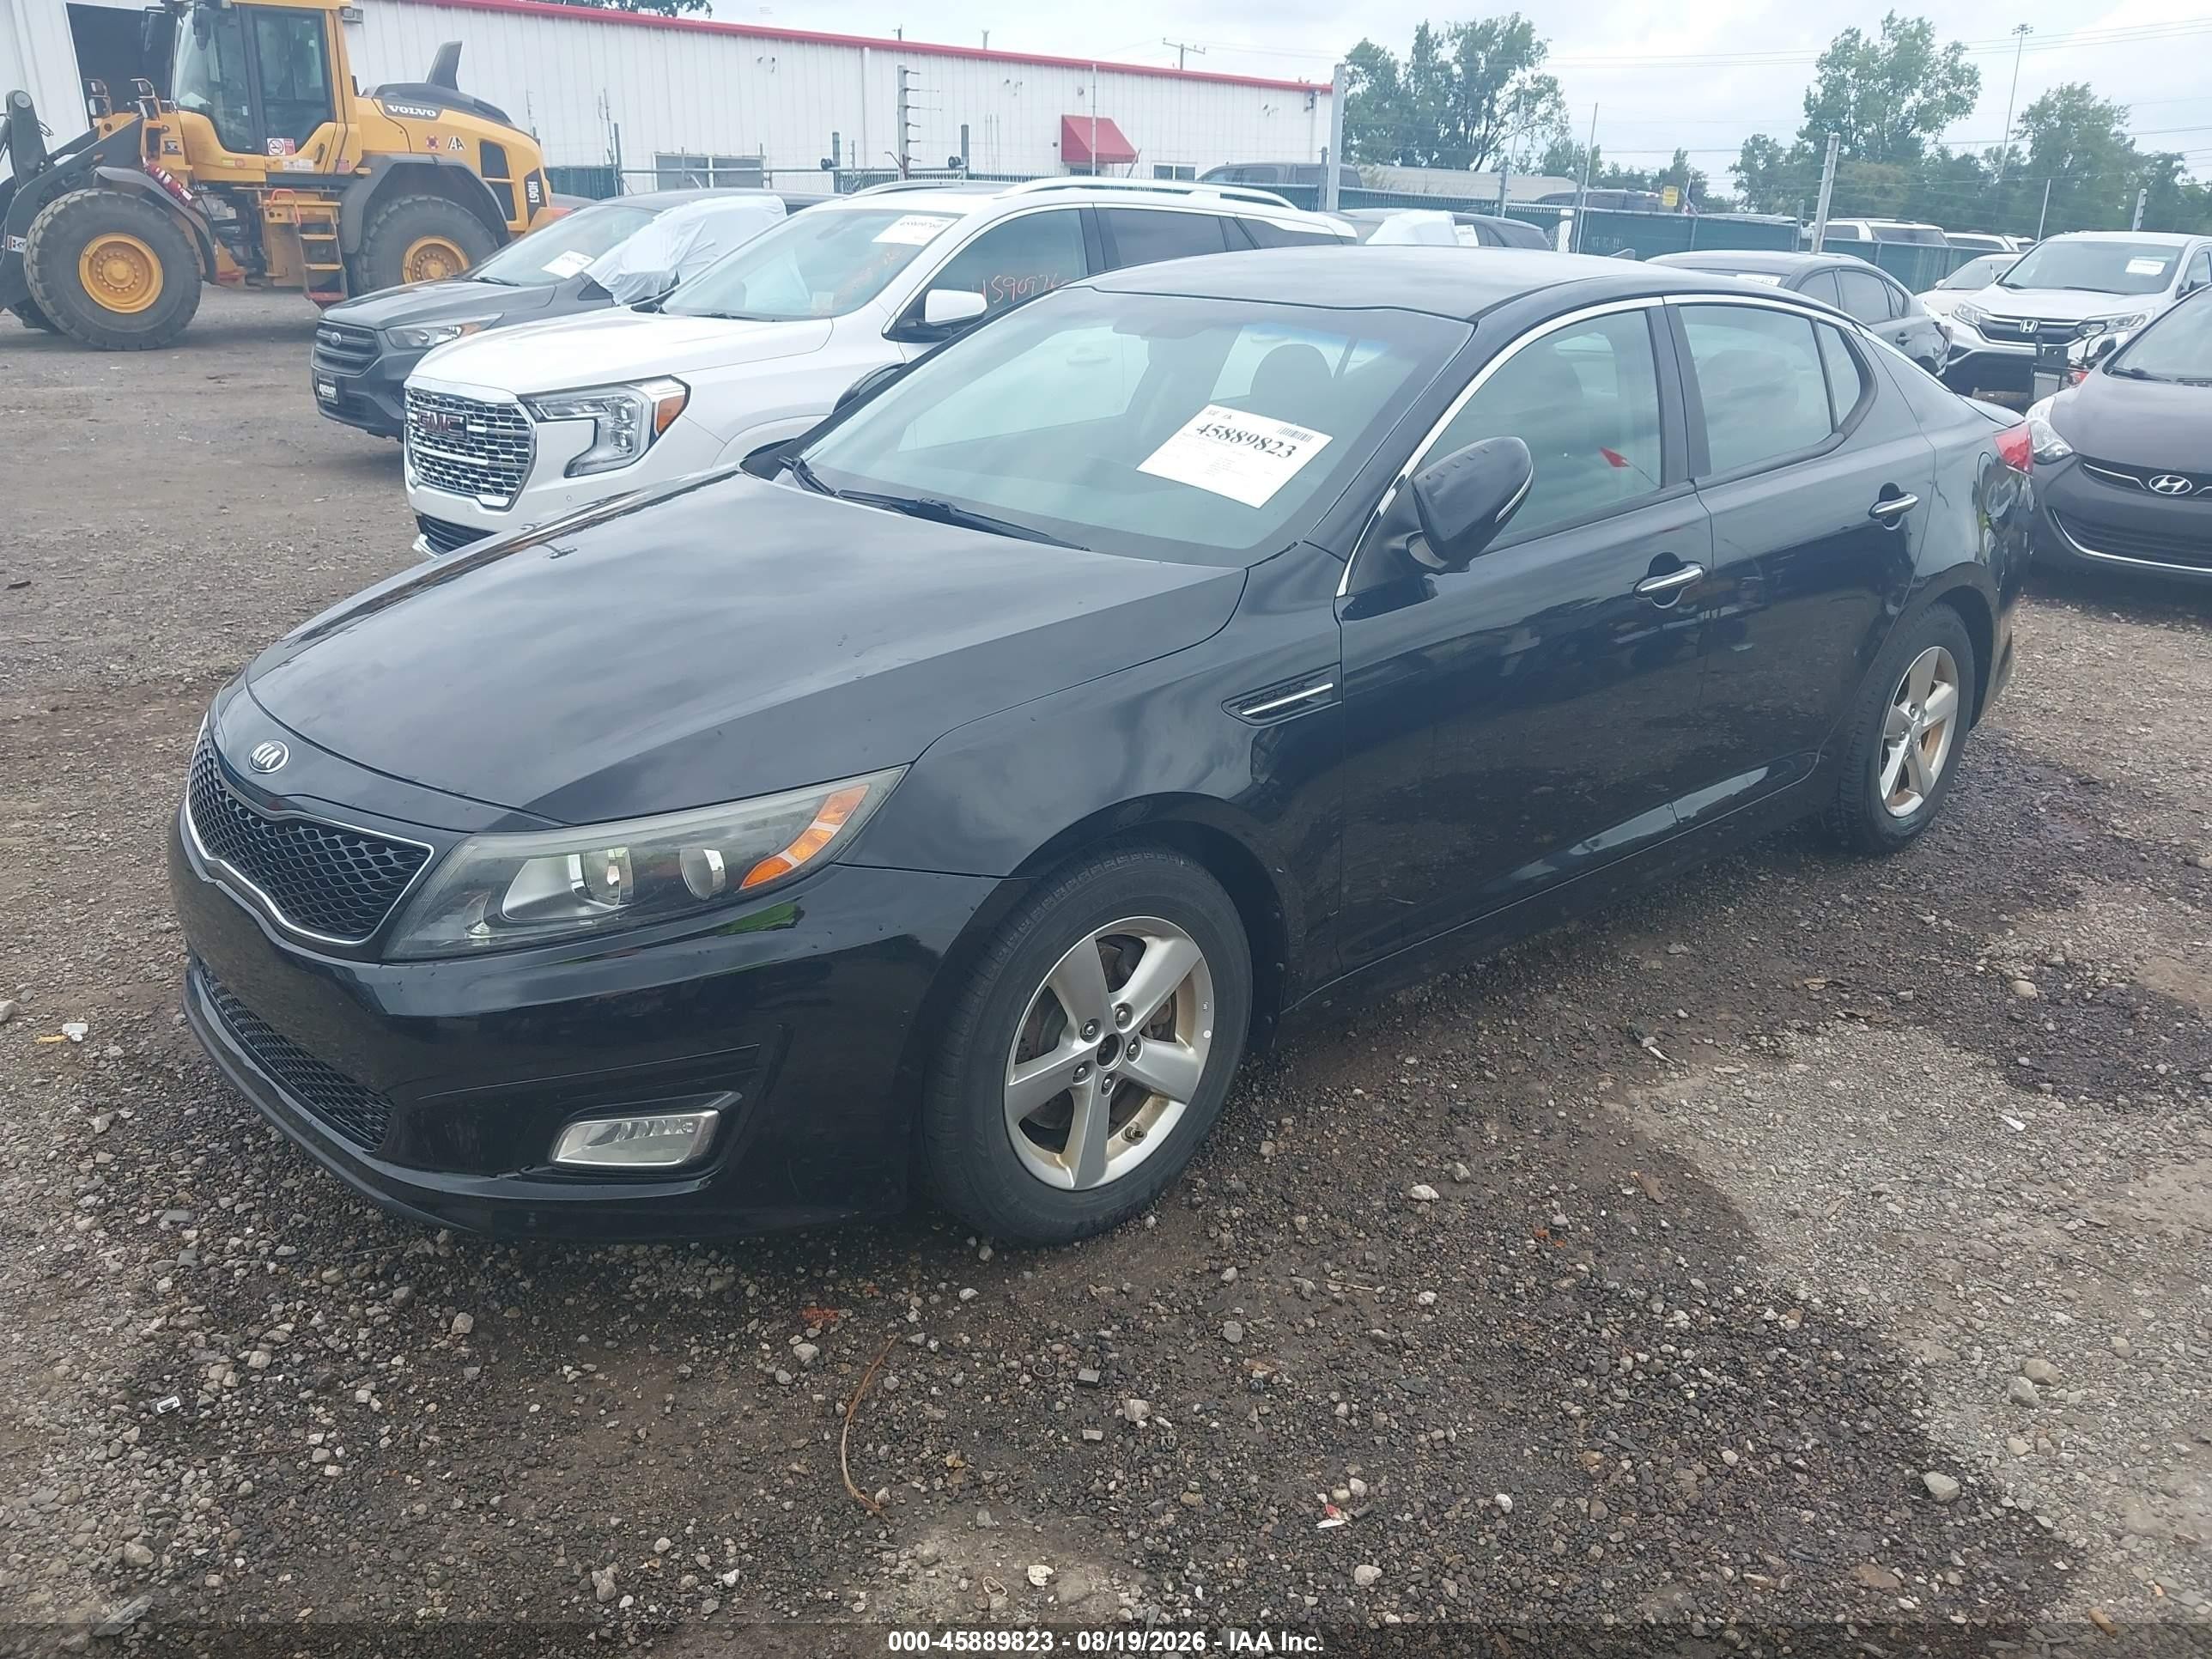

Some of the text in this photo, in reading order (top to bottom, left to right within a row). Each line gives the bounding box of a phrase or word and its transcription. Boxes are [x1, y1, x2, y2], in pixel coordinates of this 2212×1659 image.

[386, 105, 437, 118] VOLVO
[527, 181, 540, 204] L90H
[418, 410, 465, 437] GMC
[1196, 422, 1297, 459] 45889823
